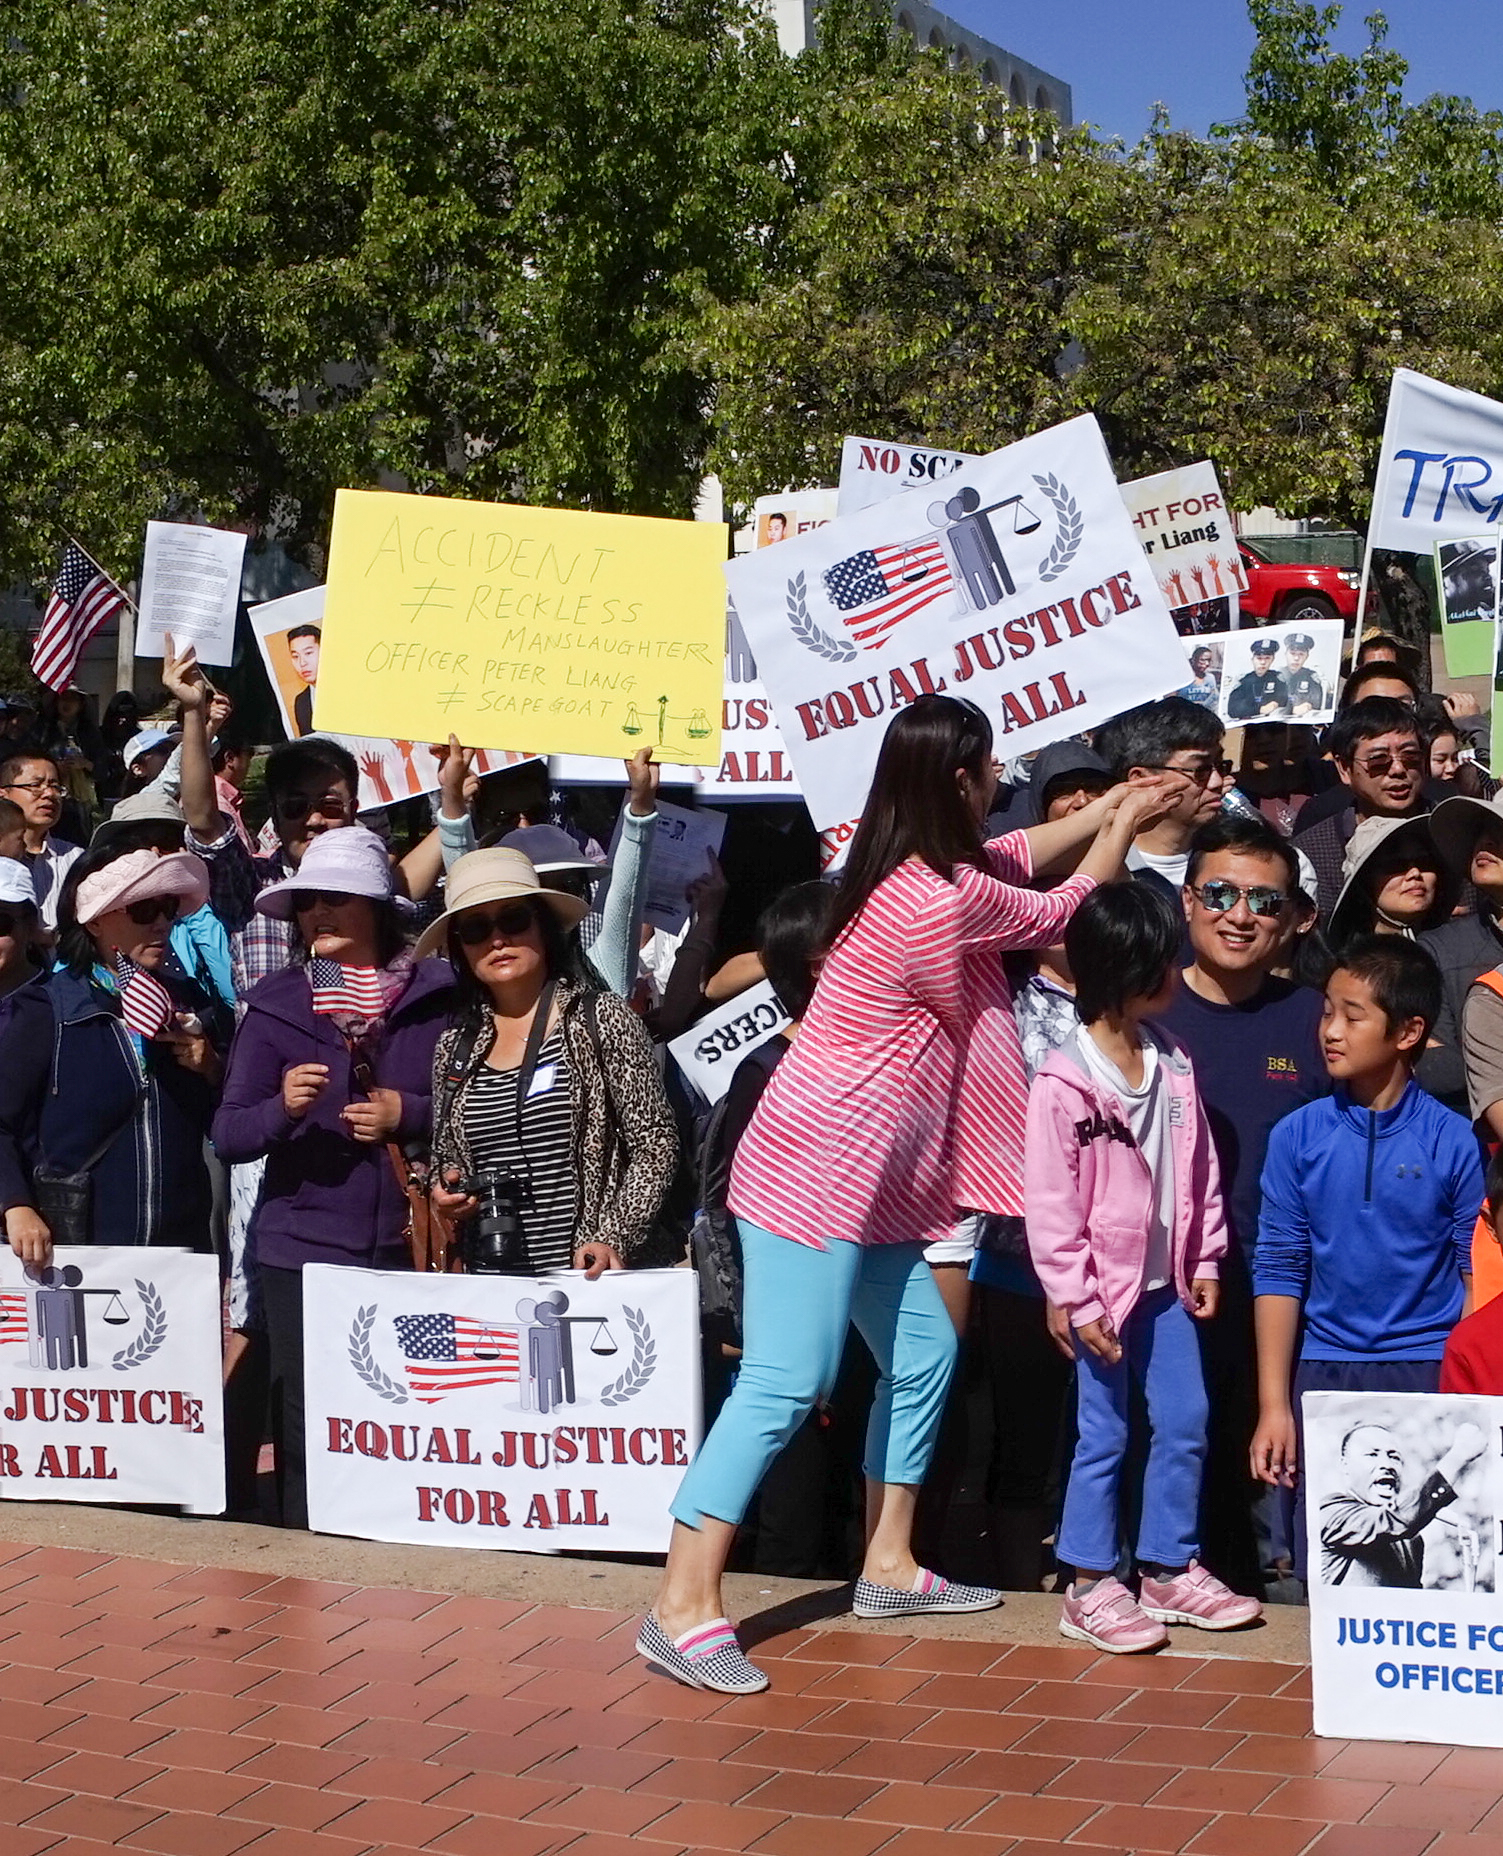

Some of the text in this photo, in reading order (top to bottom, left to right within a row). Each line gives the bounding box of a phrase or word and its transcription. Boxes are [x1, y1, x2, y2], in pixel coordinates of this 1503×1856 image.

[858, 445, 901, 474] NO
[1168, 493, 1223, 521] FOR
[365, 516, 615, 585] ACCIDENT
[1163, 523, 1219, 551] Liang
[466, 585, 643, 624] RECKLESS
[503, 628, 713, 665] MANSLAUGHTER
[795, 571, 1142, 741] EQUAL JUSTICE
[366, 642, 637, 692] OFFICER PETER LIANG
[1002, 672, 1087, 733] ALL
[716, 752, 793, 782] ALL
[1266, 1057, 1298, 1073] BSA
[4, 1388, 204, 1434] JUSTICE
[35, 1445, 118, 1480] ALL
[326, 1417, 688, 1470] EQUAL JUSTICE
[416, 1487, 610, 1530] FOR ALL
[1337, 1616, 1457, 1649] JUSTICE
